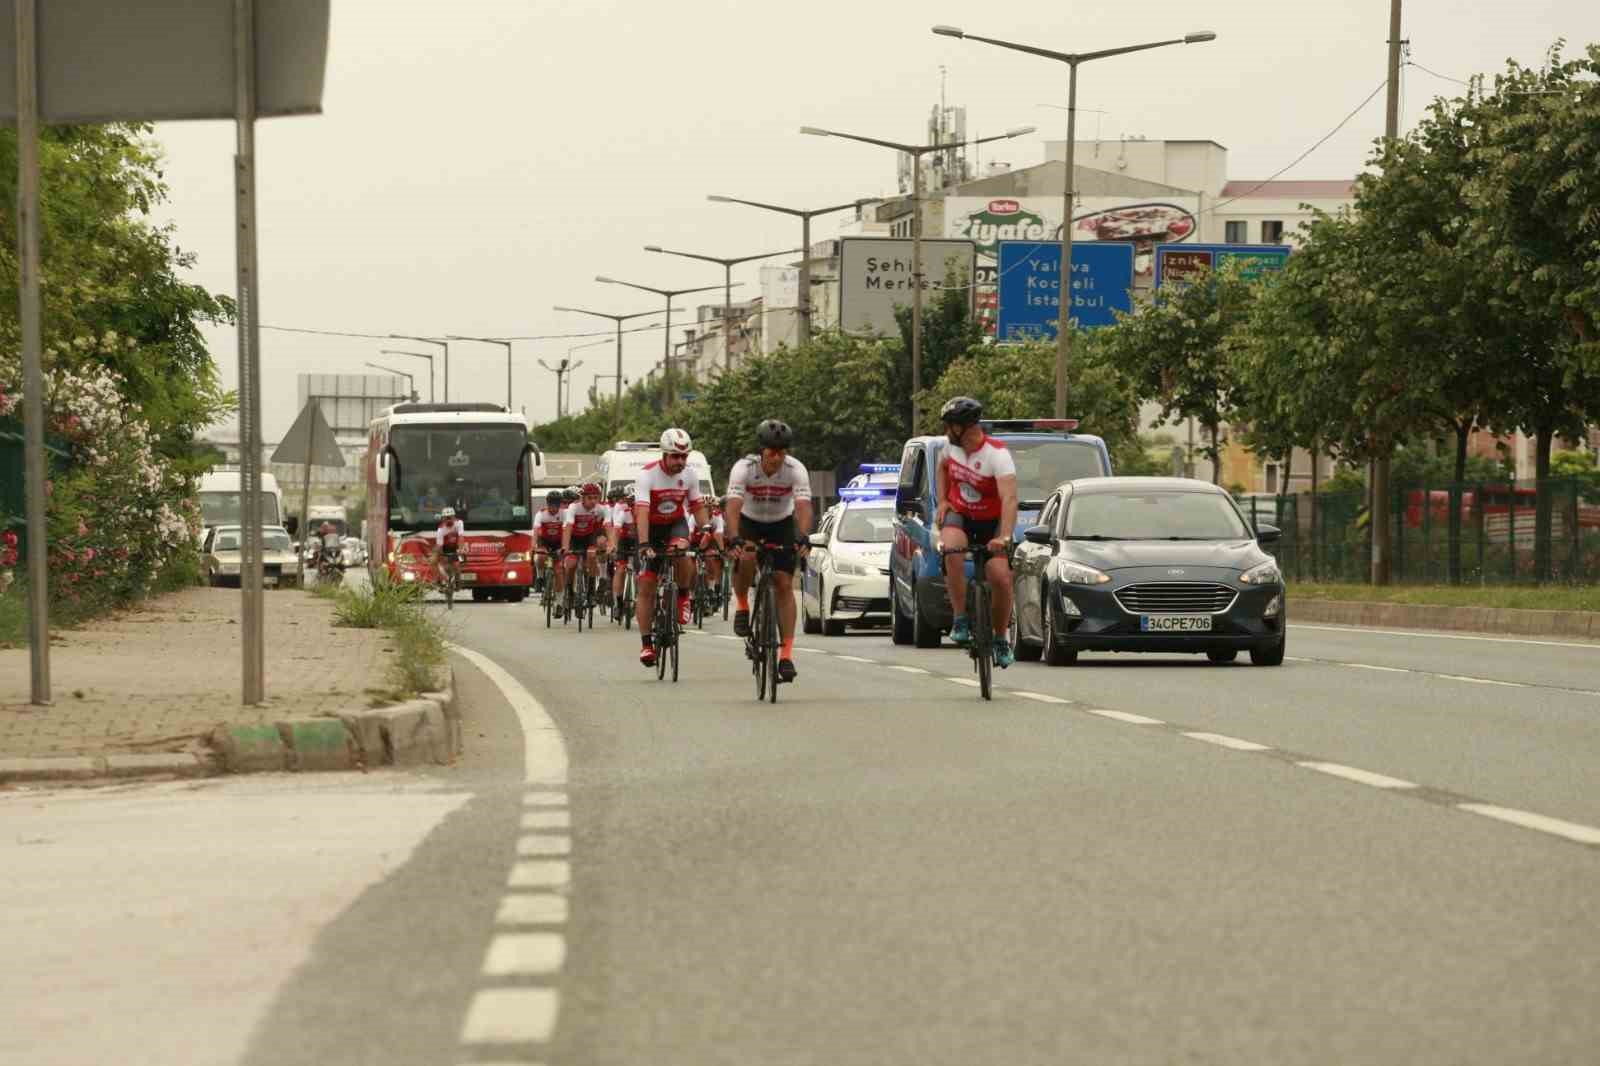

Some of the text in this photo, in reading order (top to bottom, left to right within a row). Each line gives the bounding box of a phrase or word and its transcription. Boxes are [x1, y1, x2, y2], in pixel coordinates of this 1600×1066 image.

[866, 257, 924, 274] Şehi
[1029, 259, 1090, 272] Yalva
[1027, 276, 1095, 289] Koceli
[1027, 290, 1104, 307] İstabul
[1149, 617, 1210, 630] 34CPE706
